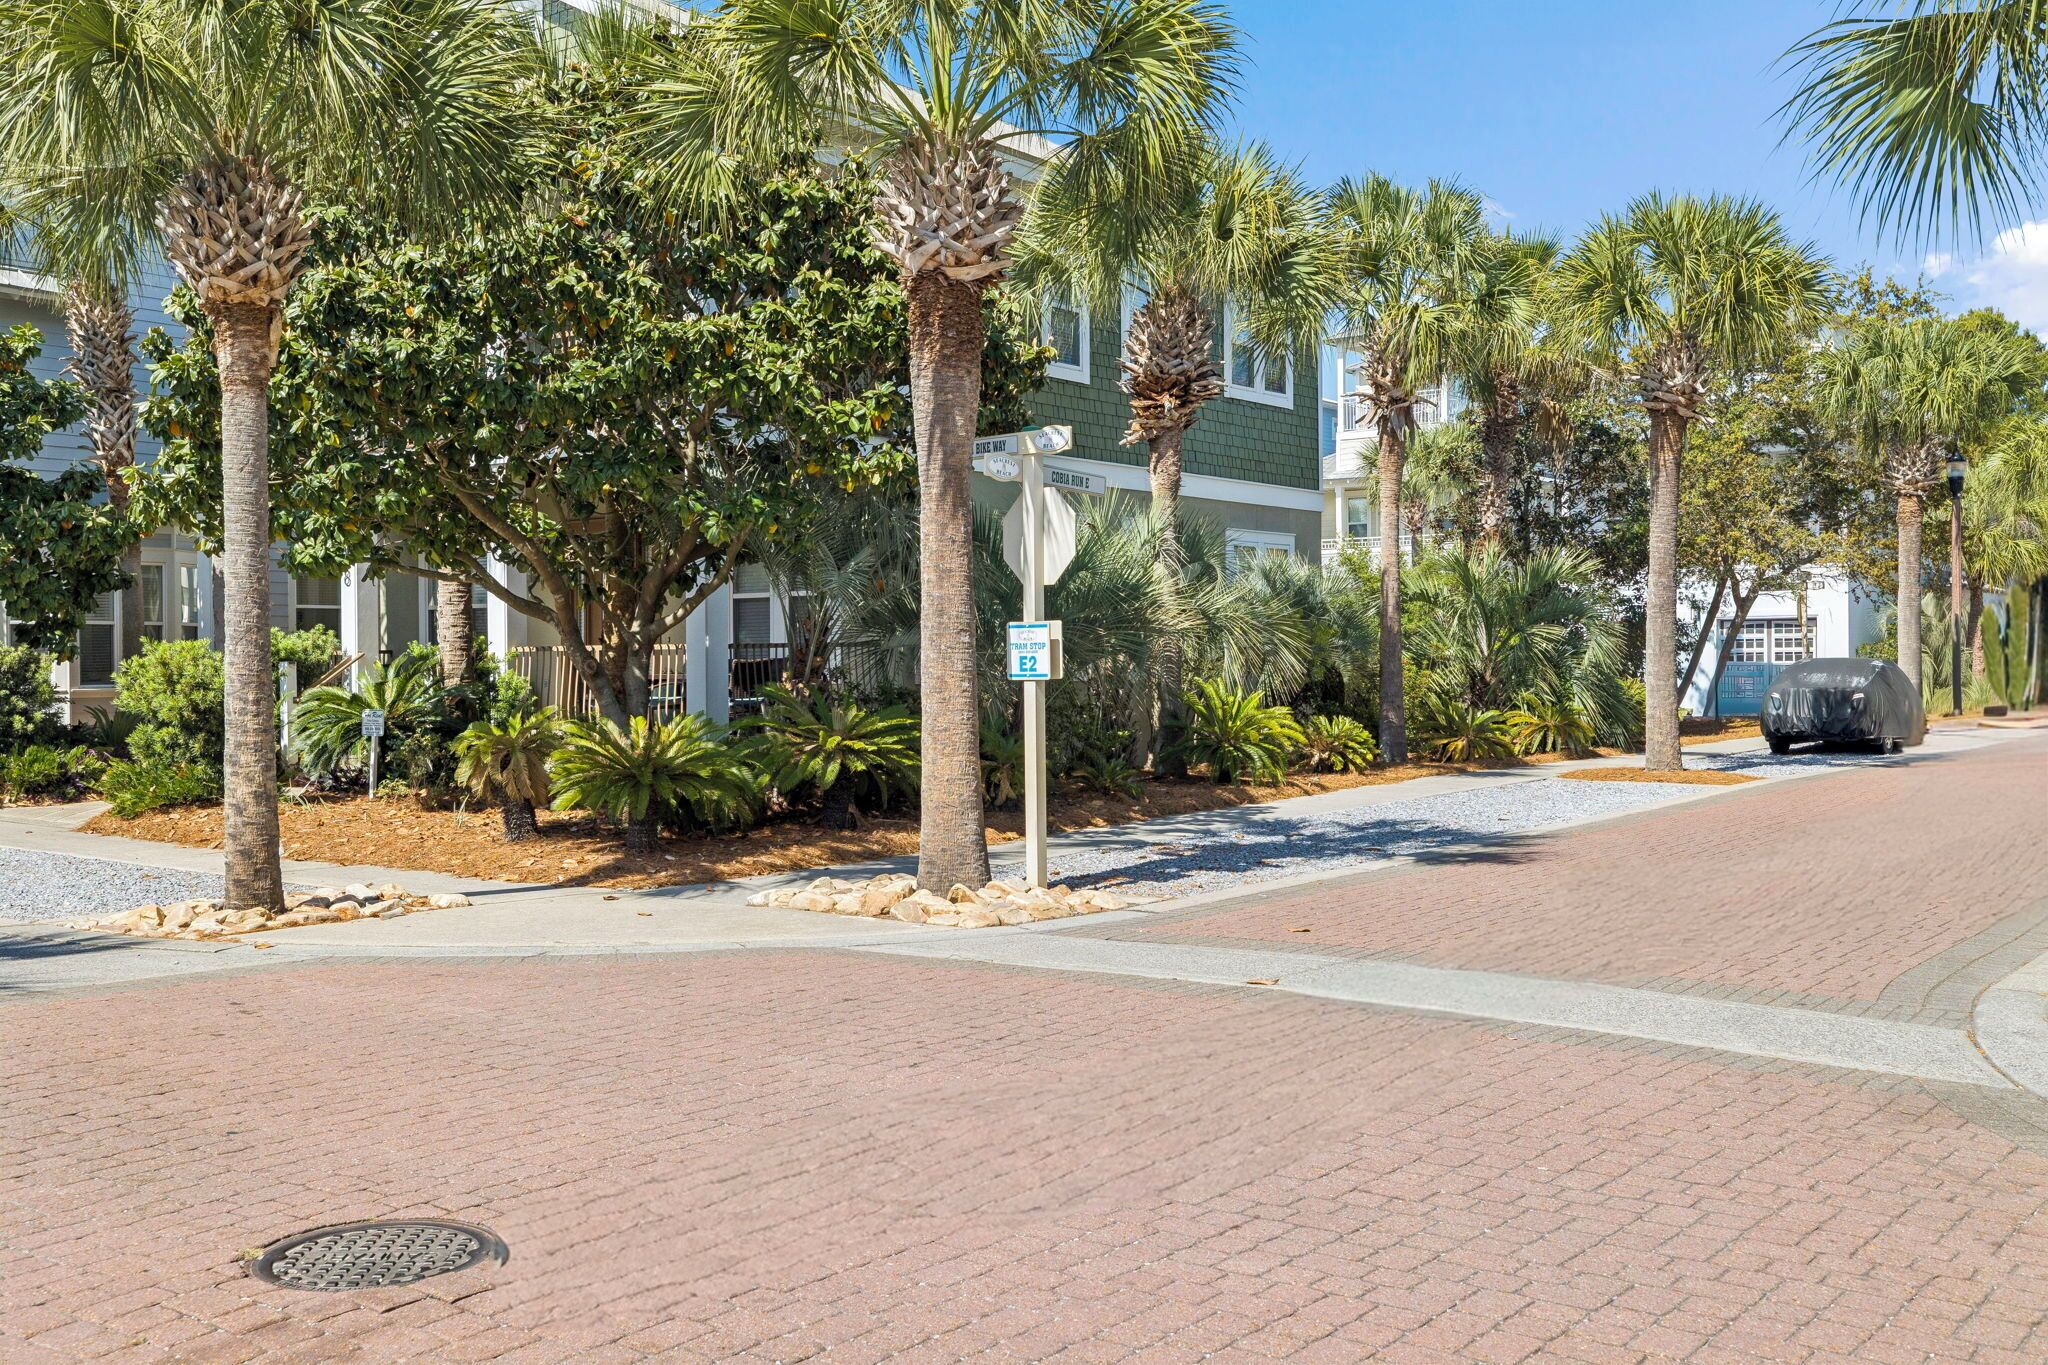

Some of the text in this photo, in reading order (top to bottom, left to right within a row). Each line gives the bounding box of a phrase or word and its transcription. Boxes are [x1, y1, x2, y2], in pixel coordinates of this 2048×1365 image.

[975, 441, 991, 454] BIKE
[993, 440, 1006, 452] WAY
[996, 469, 1012, 477] BEACH
[1051, 471, 1090, 489] COBIA RUN E
[1029, 642, 1046, 650] STOP
[1019, 655, 1037, 672] E2
